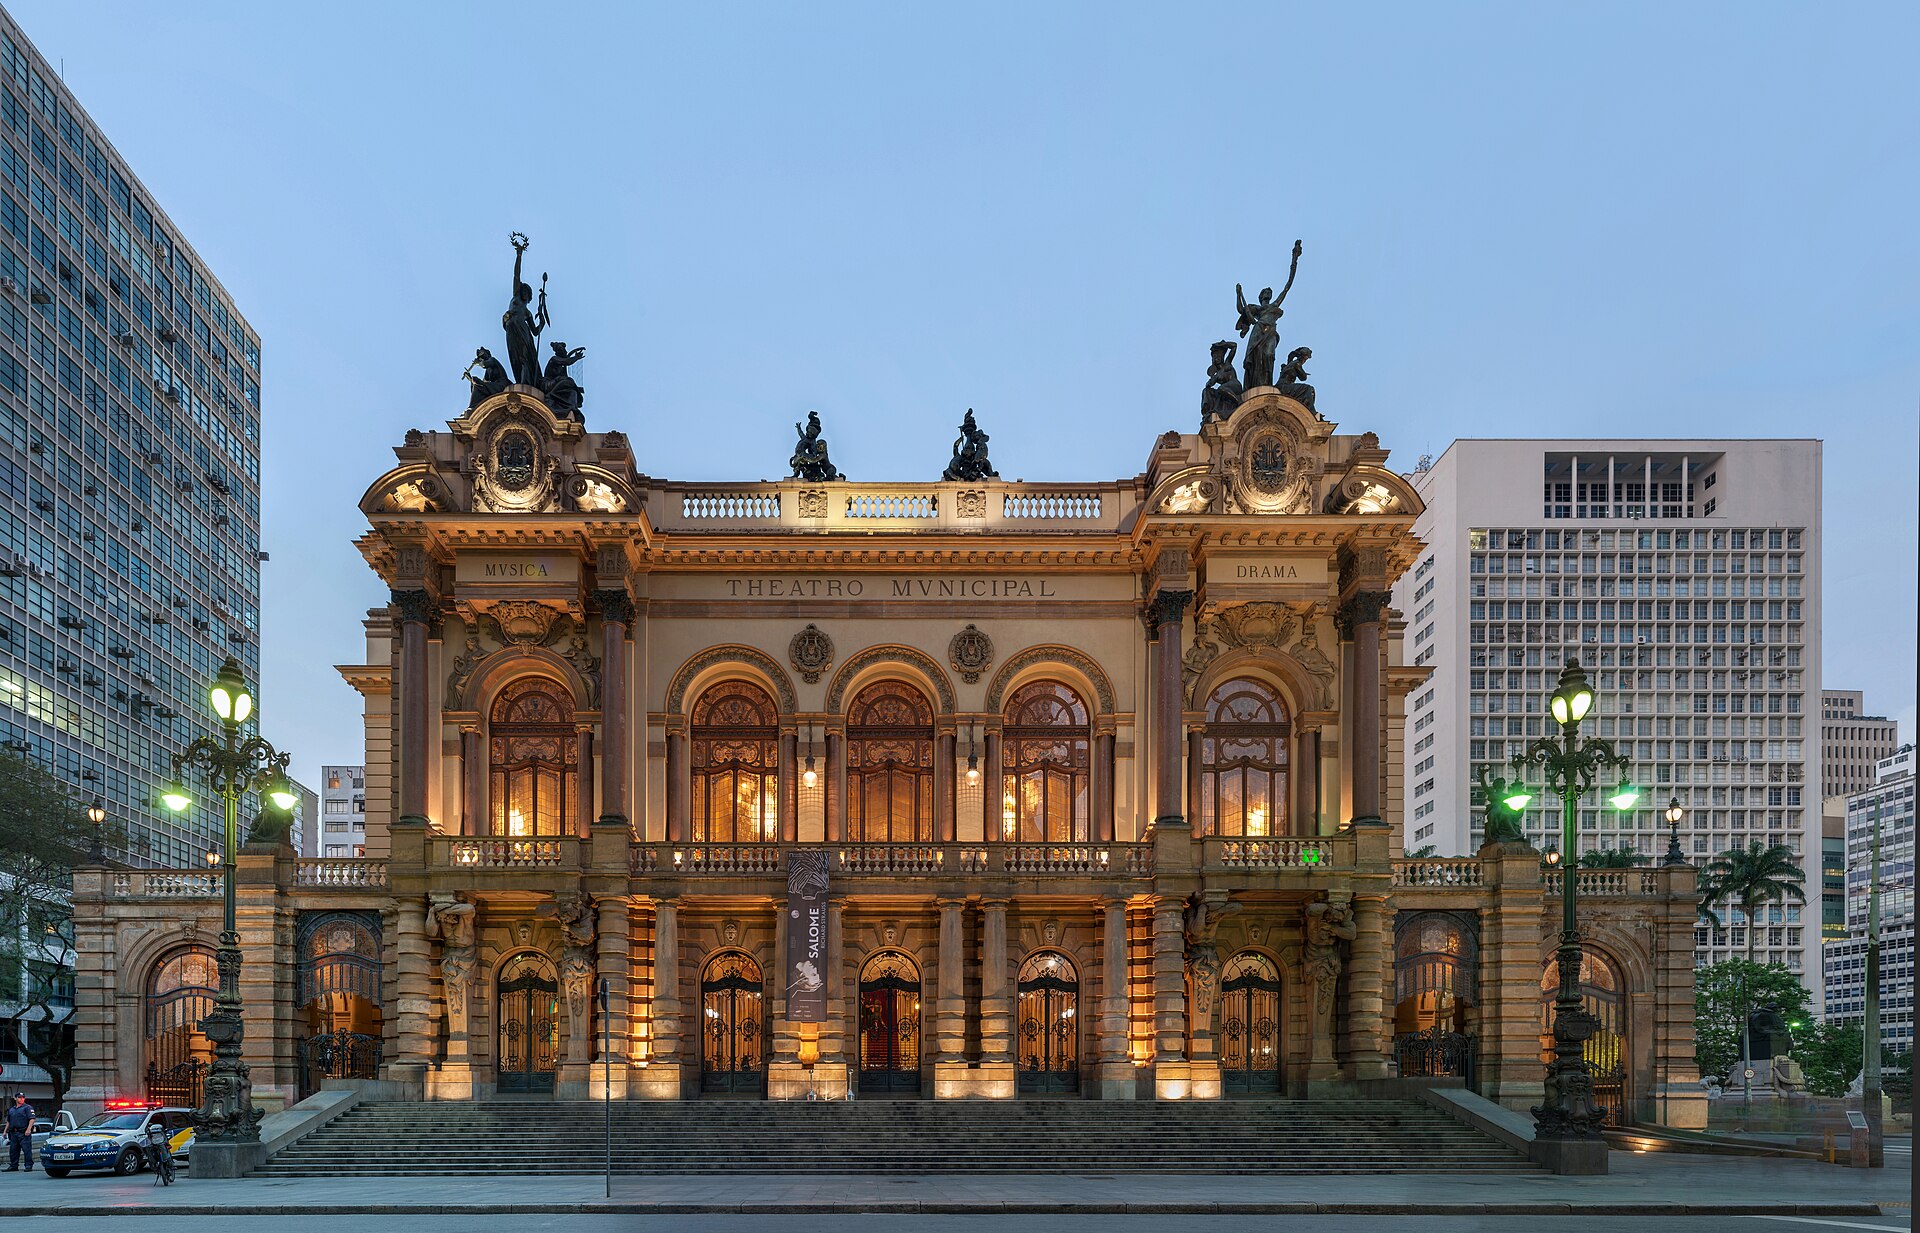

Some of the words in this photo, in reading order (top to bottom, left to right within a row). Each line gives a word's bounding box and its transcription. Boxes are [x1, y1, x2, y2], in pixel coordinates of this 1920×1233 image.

[485, 563, 548, 577] MVSICA
[1236, 565, 1298, 578] DRAMA
[726, 579, 864, 597] THEATRO
[892, 579, 1056, 597] MVNICIPAL
[808, 908, 820, 959] SALOME
